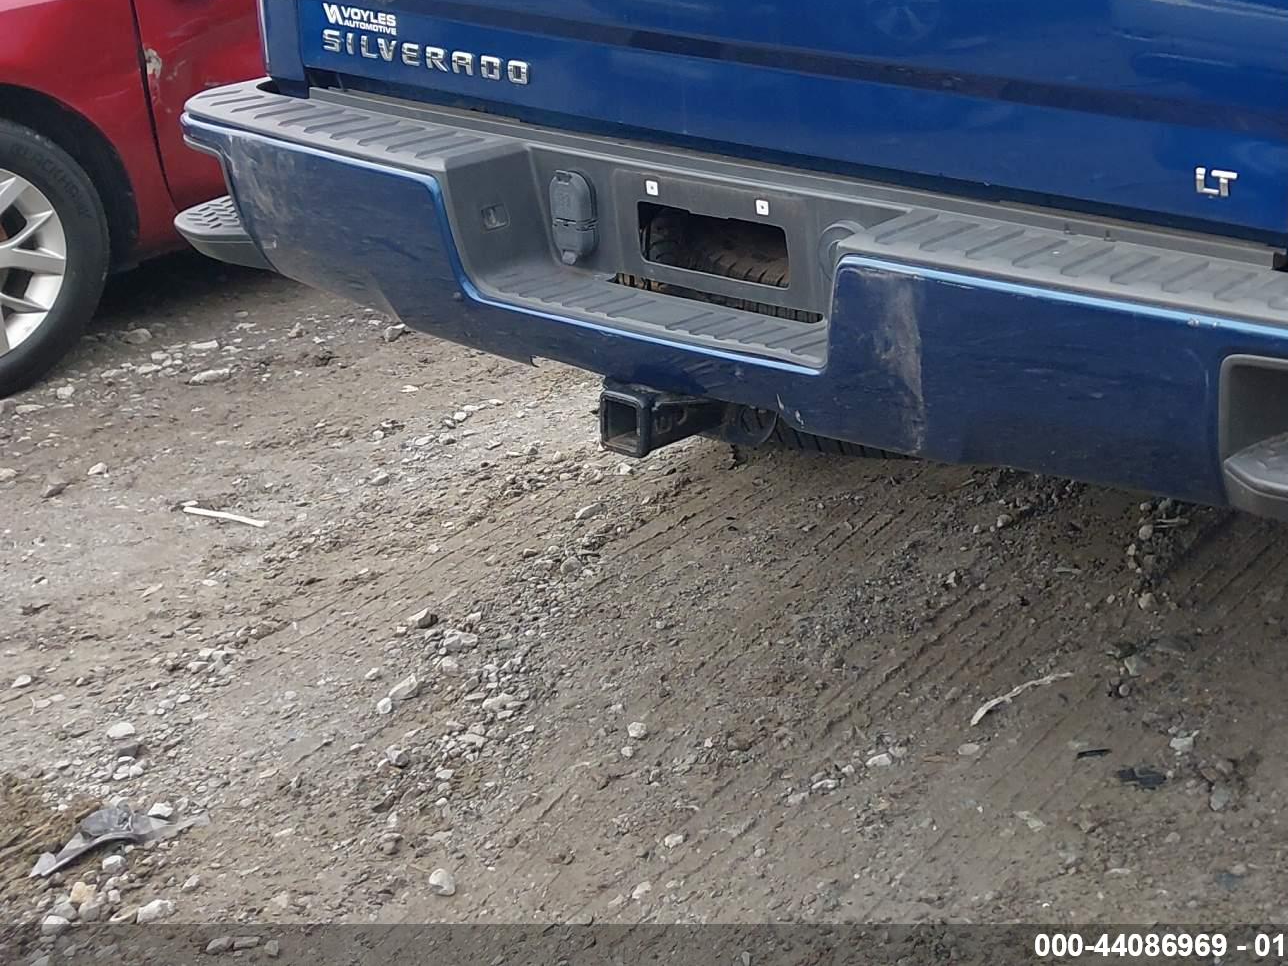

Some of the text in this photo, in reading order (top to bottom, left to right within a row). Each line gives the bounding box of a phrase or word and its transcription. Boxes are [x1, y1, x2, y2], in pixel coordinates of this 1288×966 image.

[341, 6, 396, 27] VOYLES
[343, 19, 397, 35] AUTOMOTIVE
[322, 29, 532, 85] SILVERADO
[1195, 167, 1238, 198] LT
